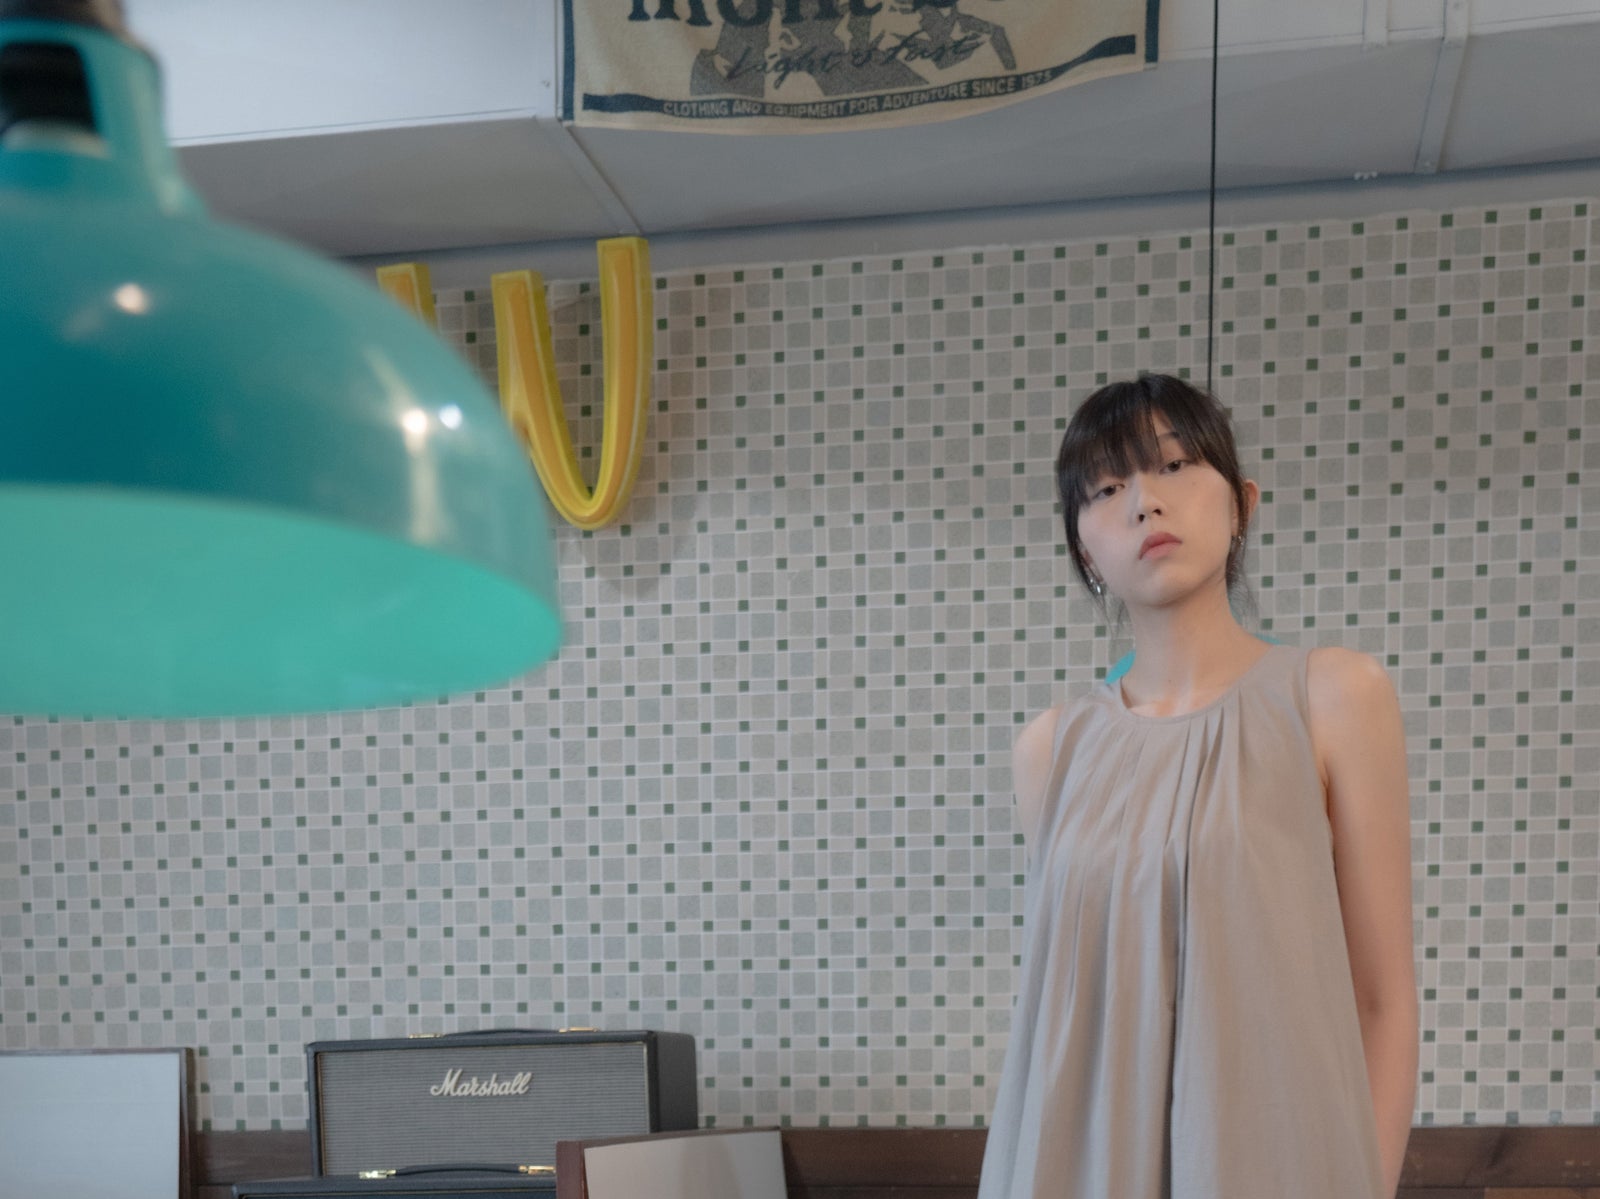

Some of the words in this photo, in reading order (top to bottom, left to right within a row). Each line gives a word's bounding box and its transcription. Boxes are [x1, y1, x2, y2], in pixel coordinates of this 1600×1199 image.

[724, 46, 843, 89] Light
[662, 101, 728, 118] CLOTHING
[731, 101, 761, 115] AND
[765, 103, 847, 118] EQUIPMENT
[850, 99, 879, 115] FOR
[881, 82, 968, 110] ADVENTURE
[971, 79, 1016, 97] SINCE
[1020, 70, 1053, 89] 1975
[430, 1068, 532, 1097] Marshall
